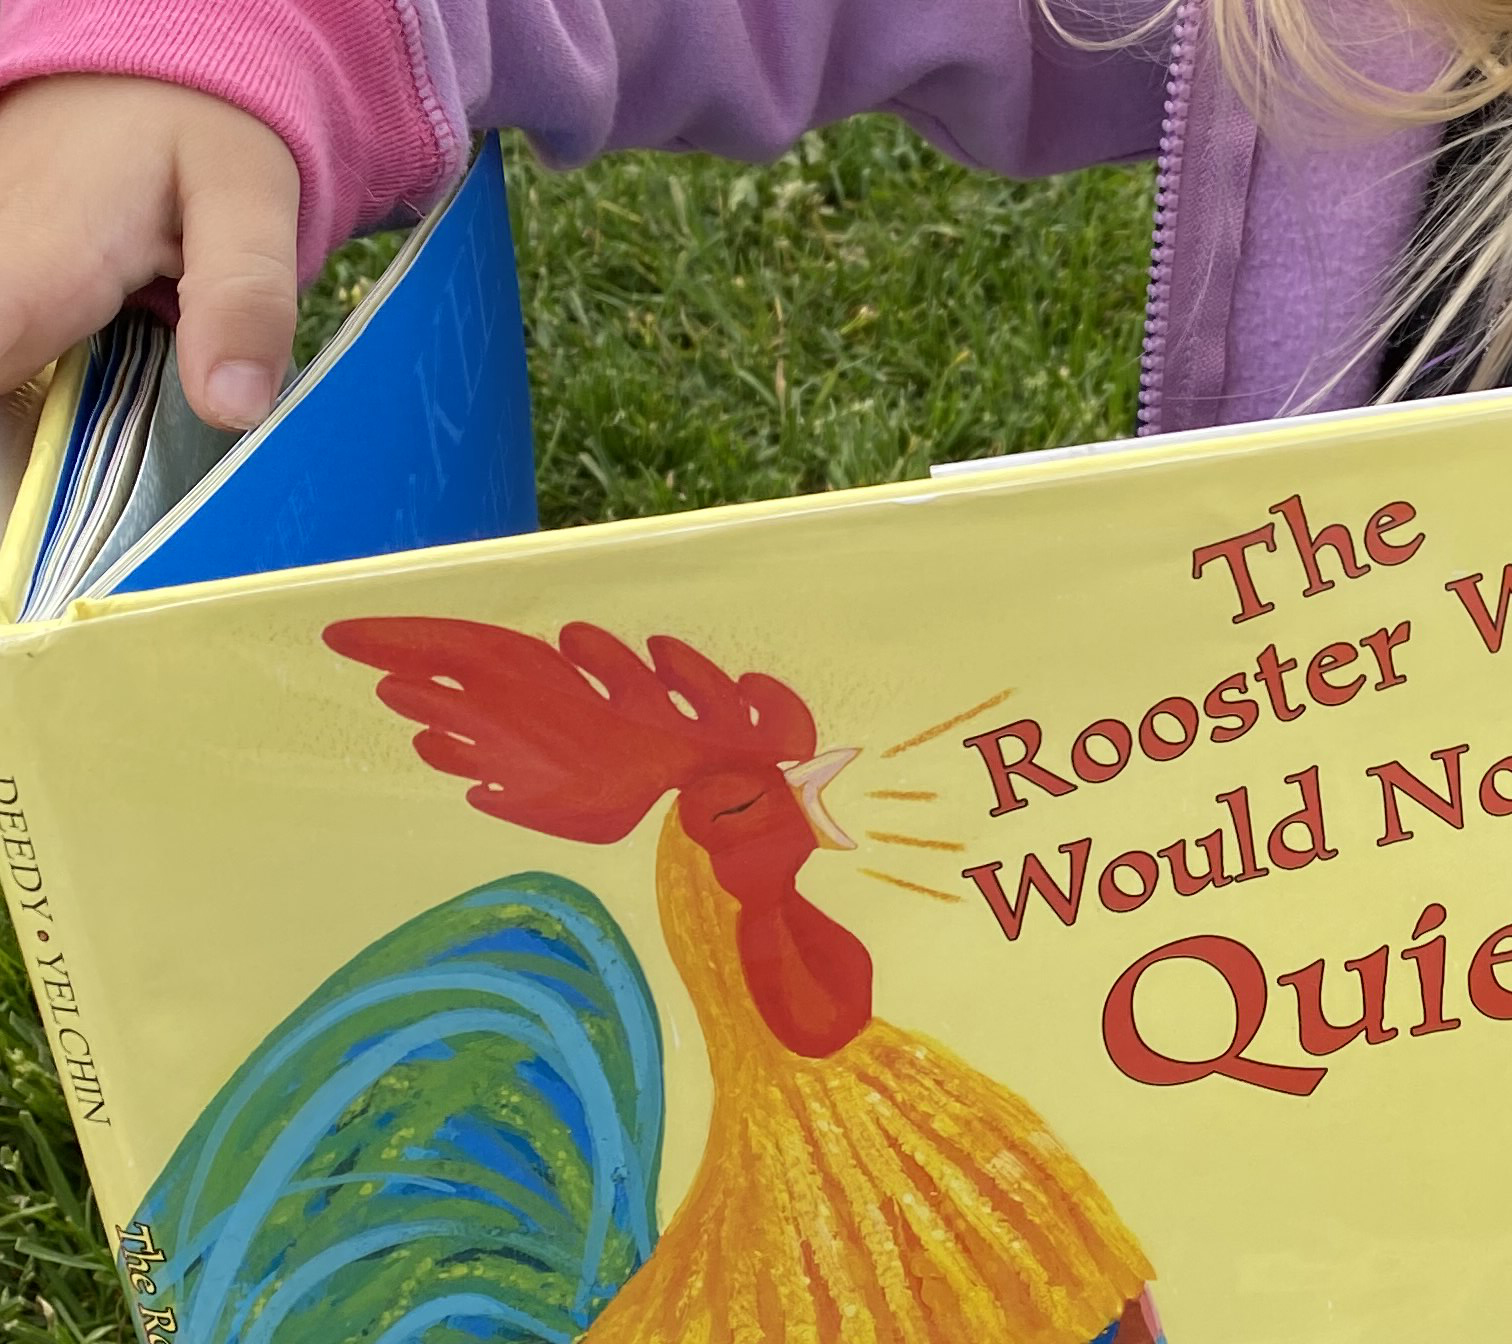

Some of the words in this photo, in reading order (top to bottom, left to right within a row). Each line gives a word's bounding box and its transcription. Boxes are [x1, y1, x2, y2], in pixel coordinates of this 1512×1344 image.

[1191, 493, 1426, 624] The
[962, 619, 1412, 819] Rooster
[962, 764, 1338, 942] Would
[0, 775, 54, 923] DEEDY
[36, 951, 112, 1128] YELCHIN
[115, 1220, 167, 1296] The
